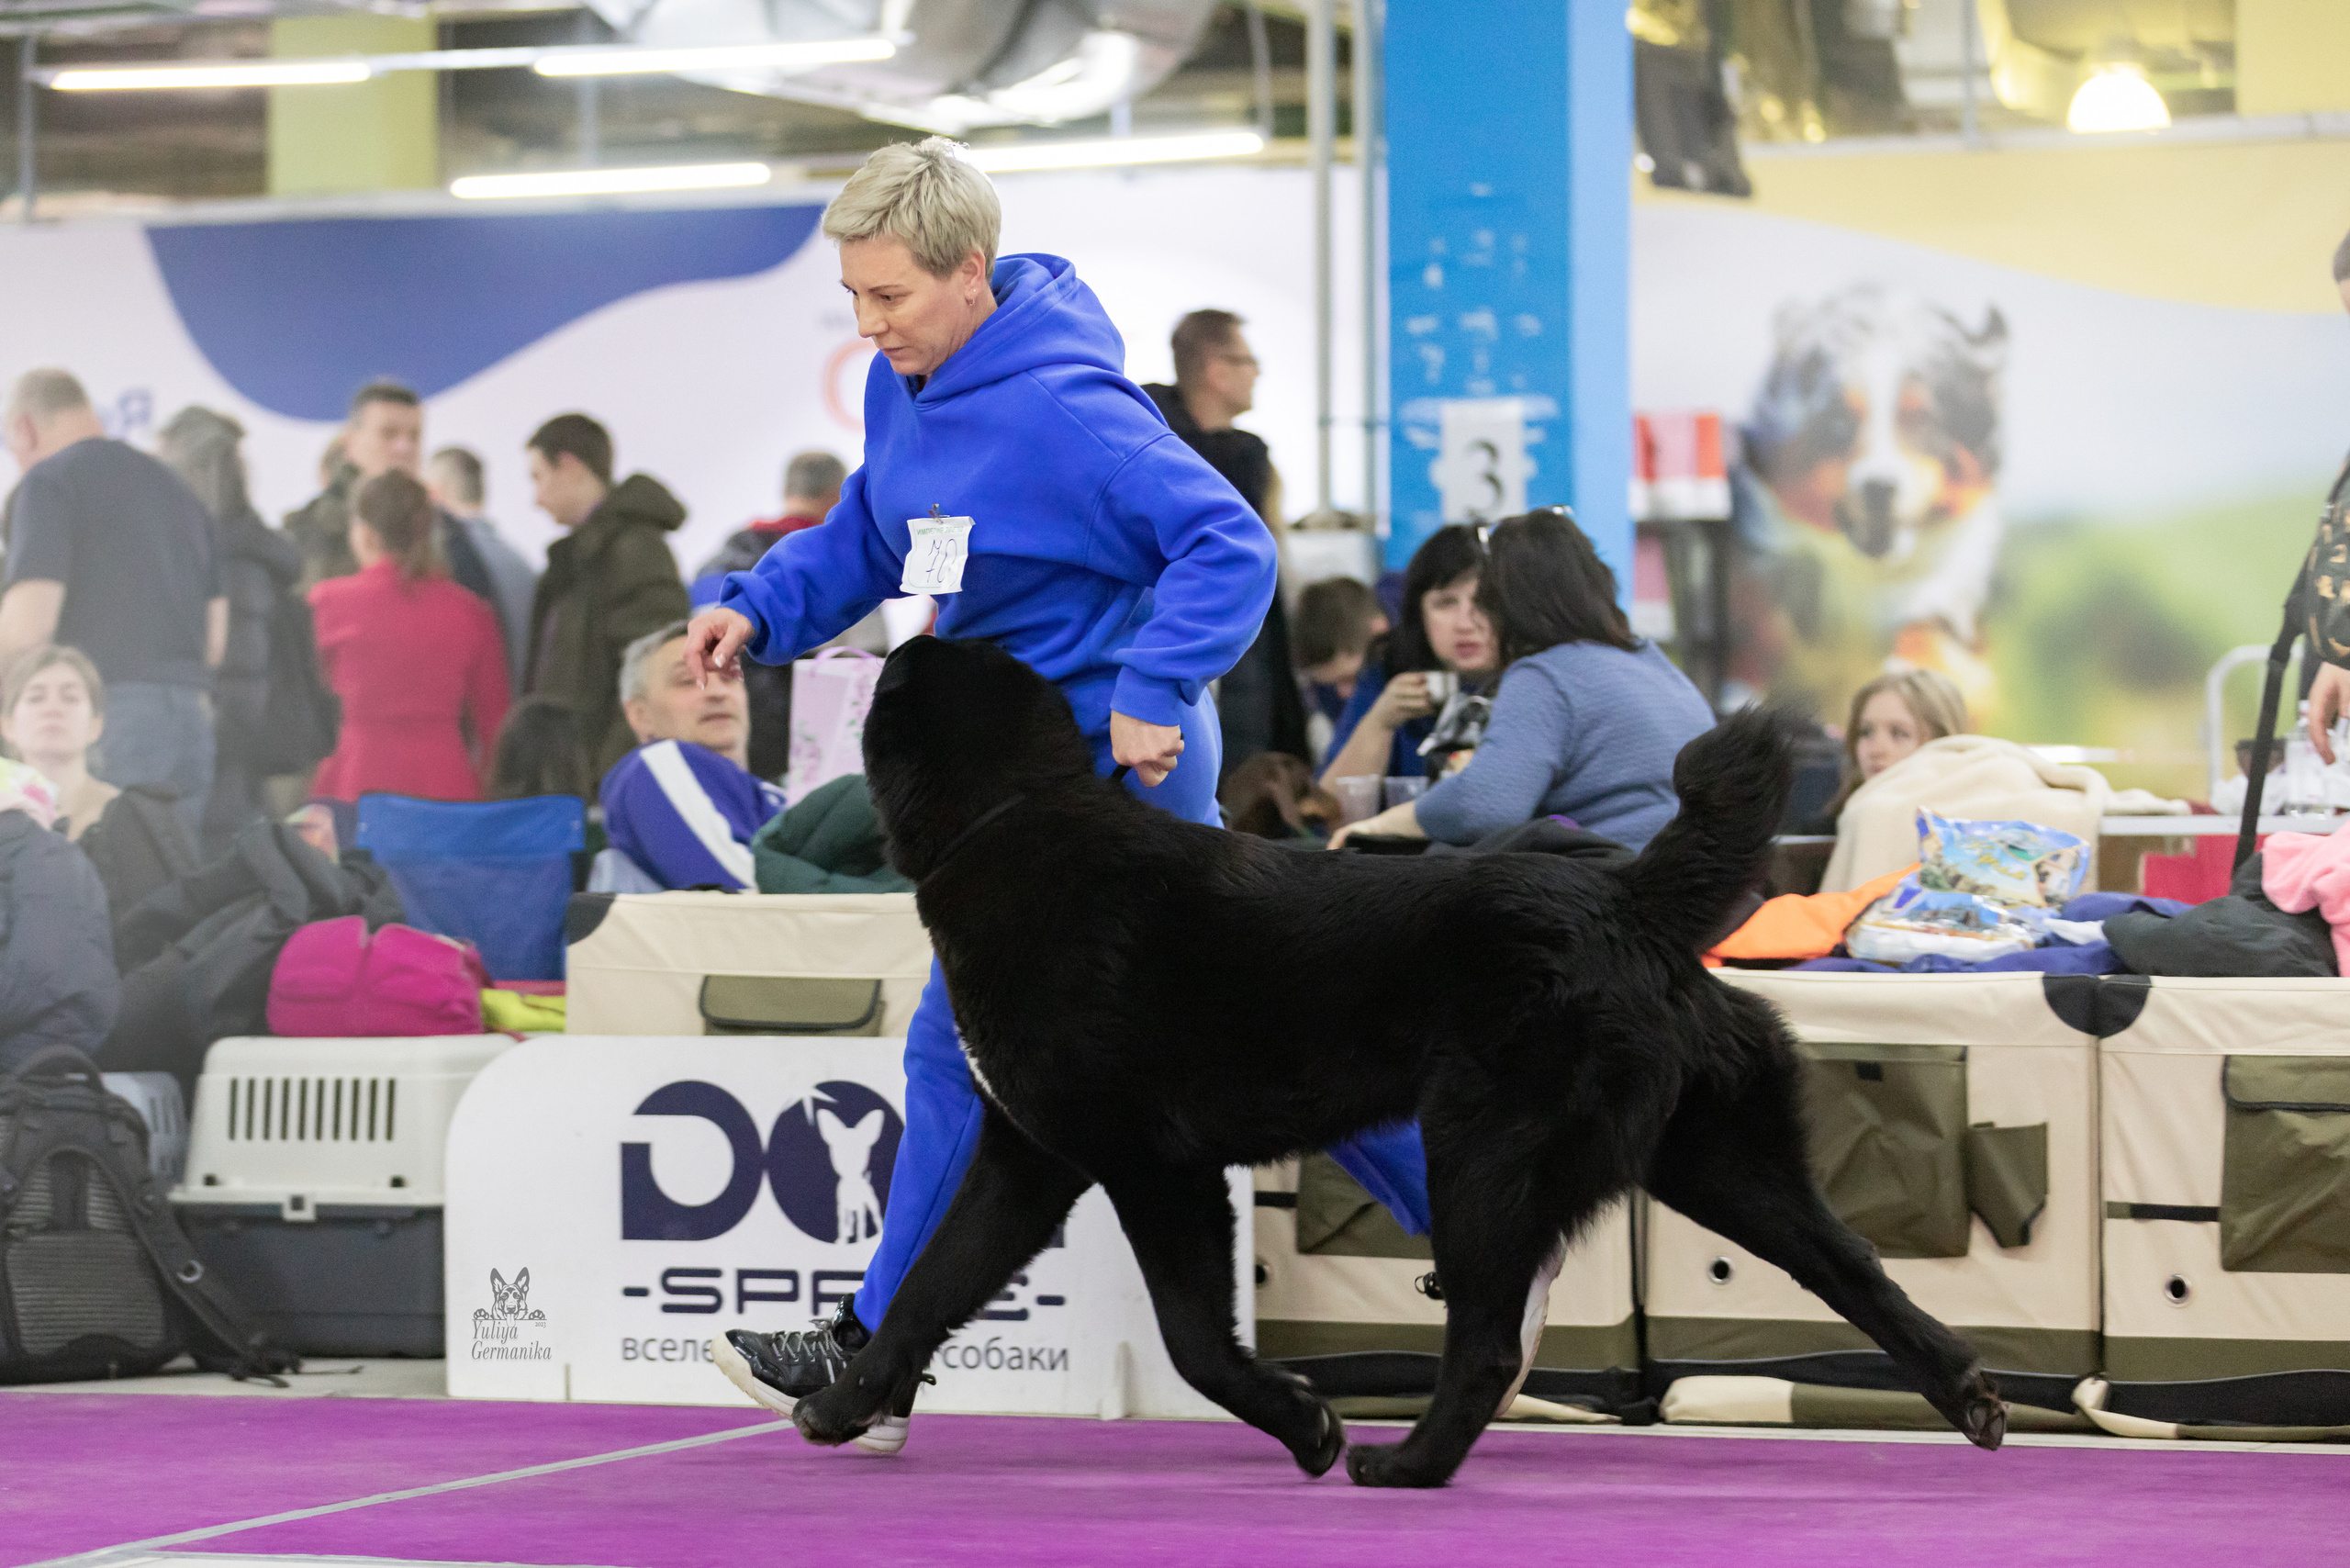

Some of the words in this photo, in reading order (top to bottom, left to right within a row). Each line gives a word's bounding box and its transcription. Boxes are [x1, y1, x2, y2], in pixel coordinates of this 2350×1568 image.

[1467, 439, 1505, 521] 3
[621, 1337, 714, 1362] вселе
[942, 1337, 1069, 1371] собаки
